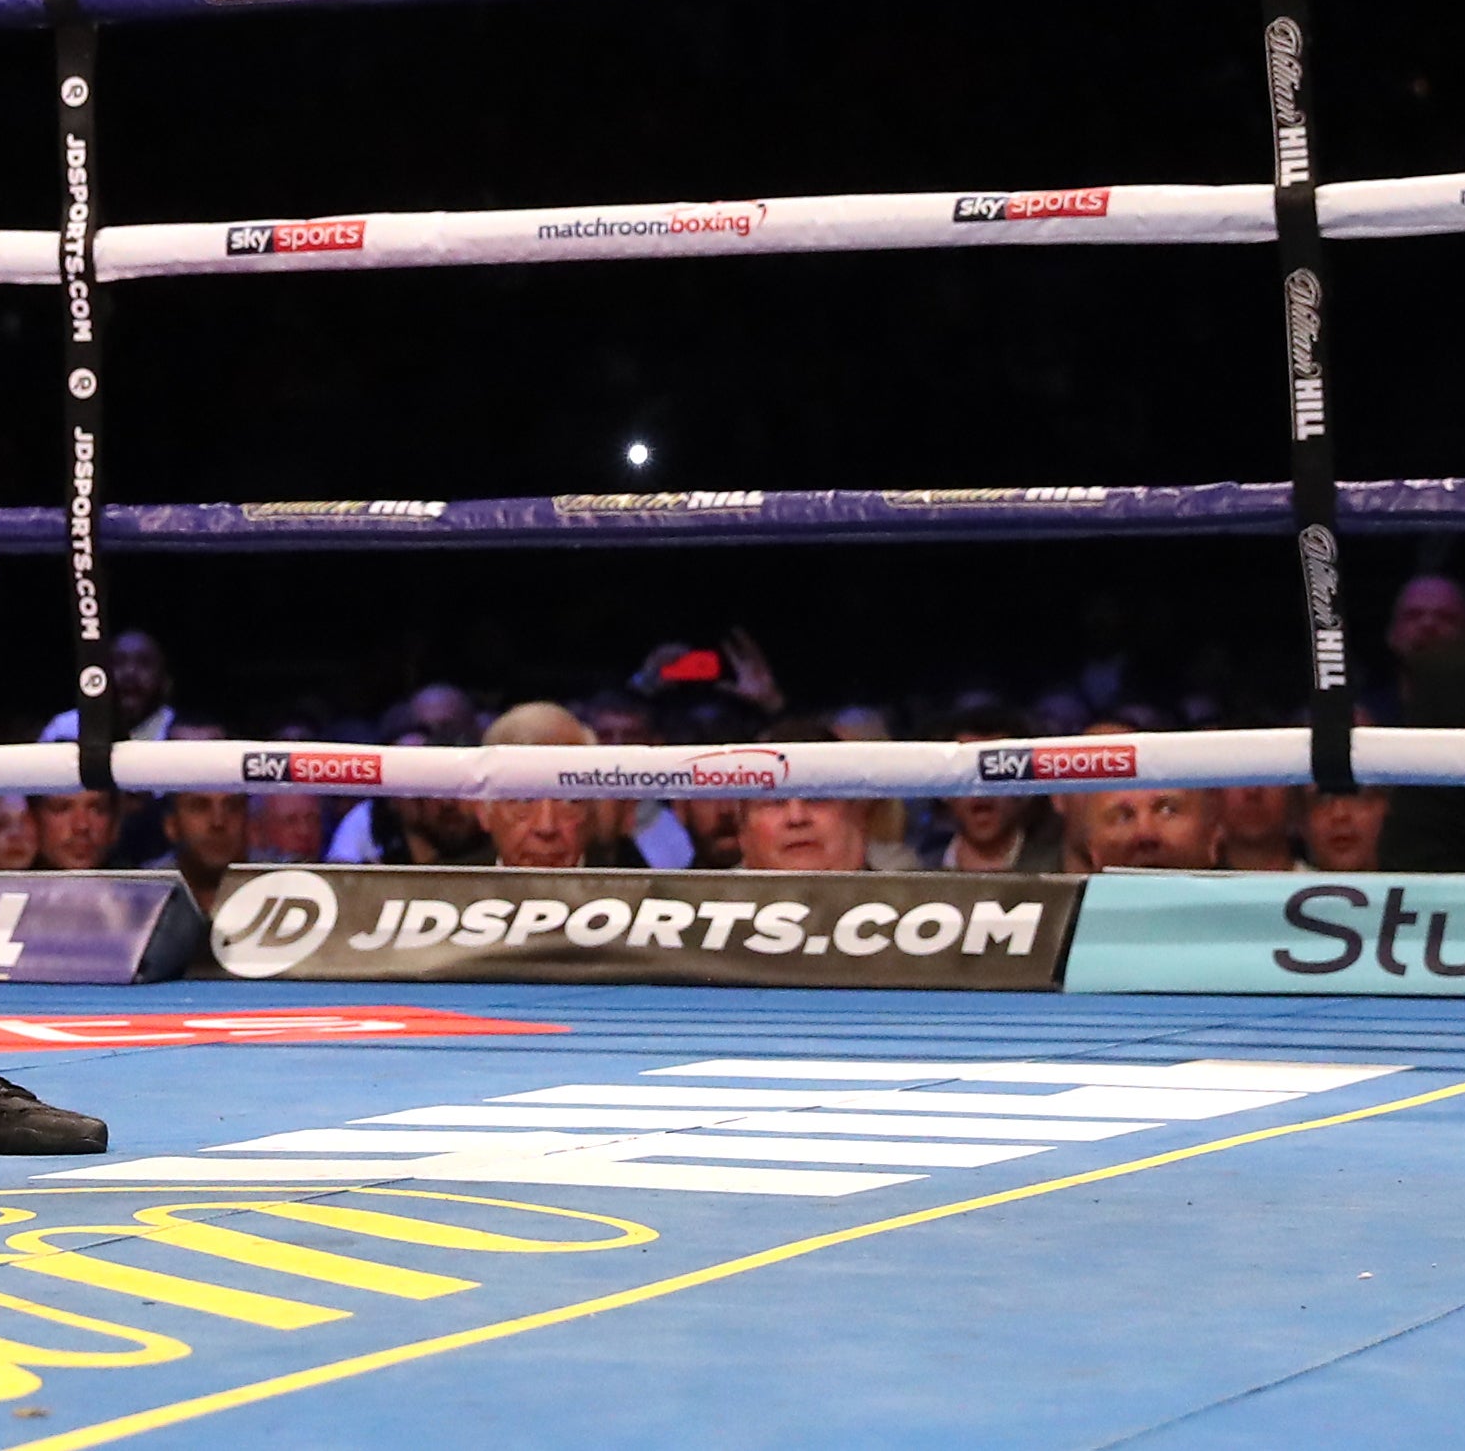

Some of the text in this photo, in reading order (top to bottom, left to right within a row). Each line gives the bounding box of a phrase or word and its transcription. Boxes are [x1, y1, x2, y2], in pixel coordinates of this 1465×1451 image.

[1278, 125, 1310, 188] HILL
[537, 211, 751, 240] matchroomboxing
[958, 189, 1104, 219] sky sports
[64, 132, 94, 343] JDSPORTS.COM
[231, 222, 361, 253] sky sports
[1294, 378, 1326, 441] HILL
[71, 425, 100, 641] JDSPORTS.COM
[1316, 629, 1347, 690] HILL
[245, 753, 377, 782] sky sports
[558, 761, 775, 789] matchroomboxing
[982, 746, 1132, 780] sky sports
[347, 897, 1045, 958] JDSPORTS.COM
